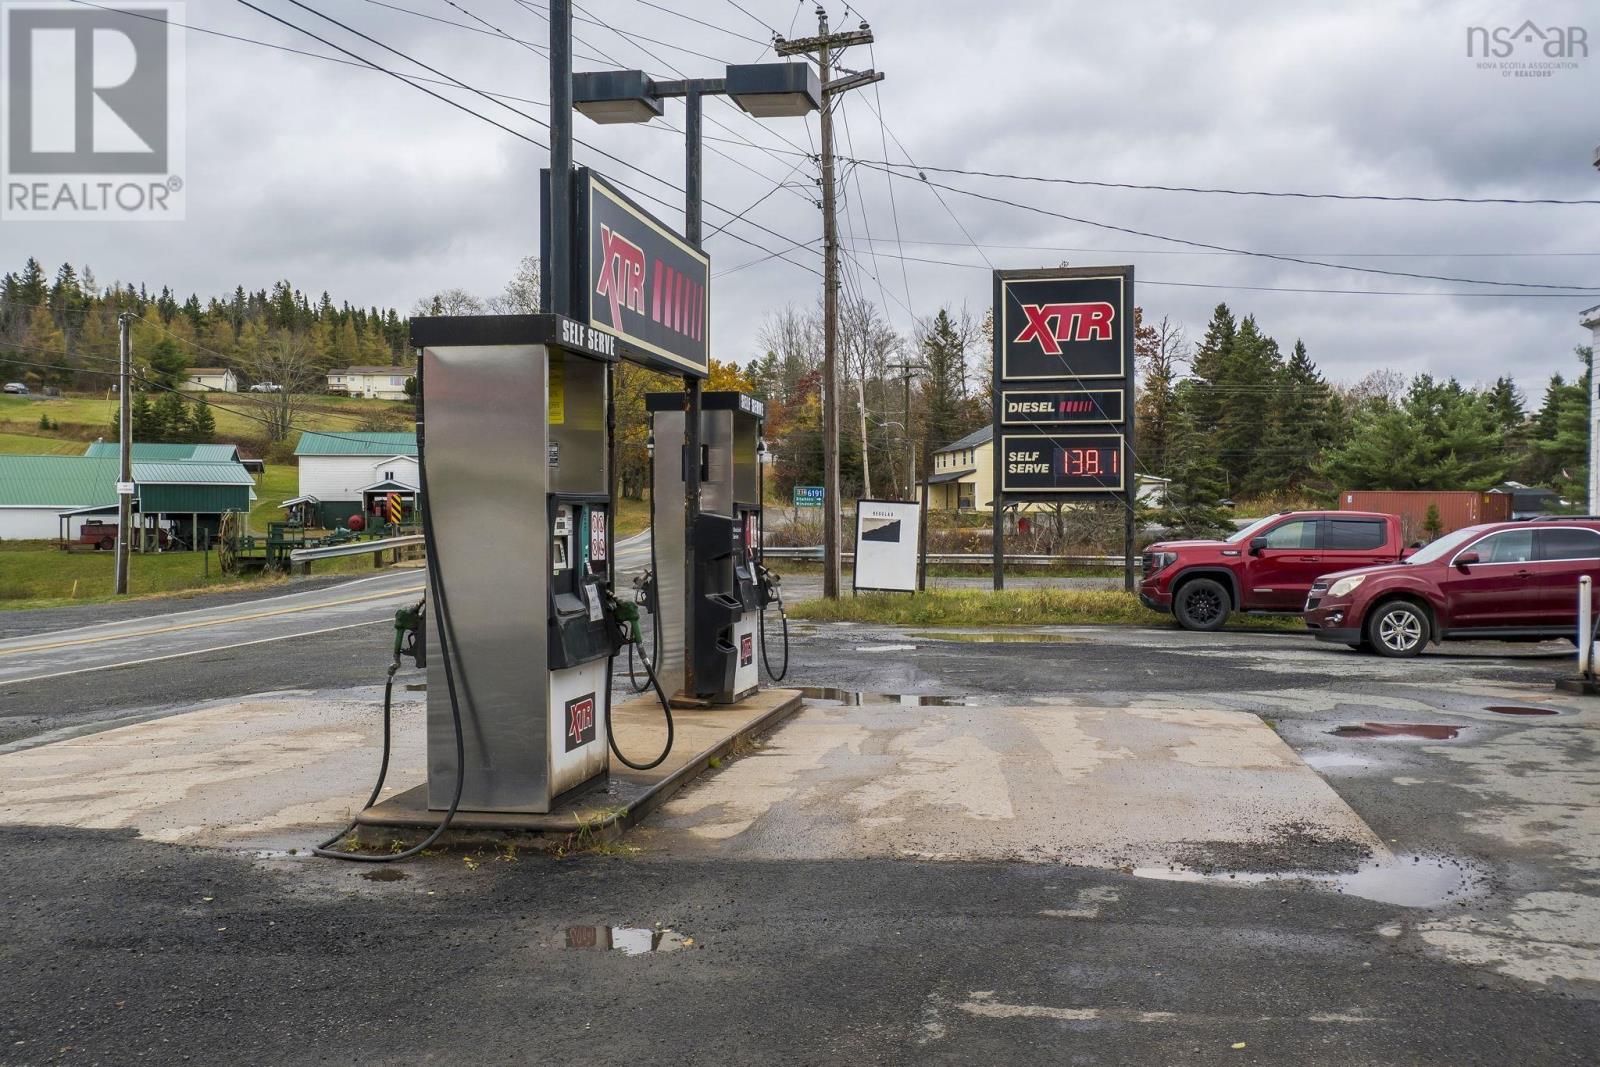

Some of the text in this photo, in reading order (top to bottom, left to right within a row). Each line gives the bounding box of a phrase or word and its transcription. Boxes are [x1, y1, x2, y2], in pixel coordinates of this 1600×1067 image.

[596, 222, 645, 333] XTR
[562, 319, 615, 356] SELF SERVE
[1013, 301, 1116, 355] XTR
[1007, 402, 1056, 413] DIESEL
[1008, 451, 1040, 462] SELF
[1008, 463, 1050, 474] SERVE
[568, 698, 593, 744] XTR
